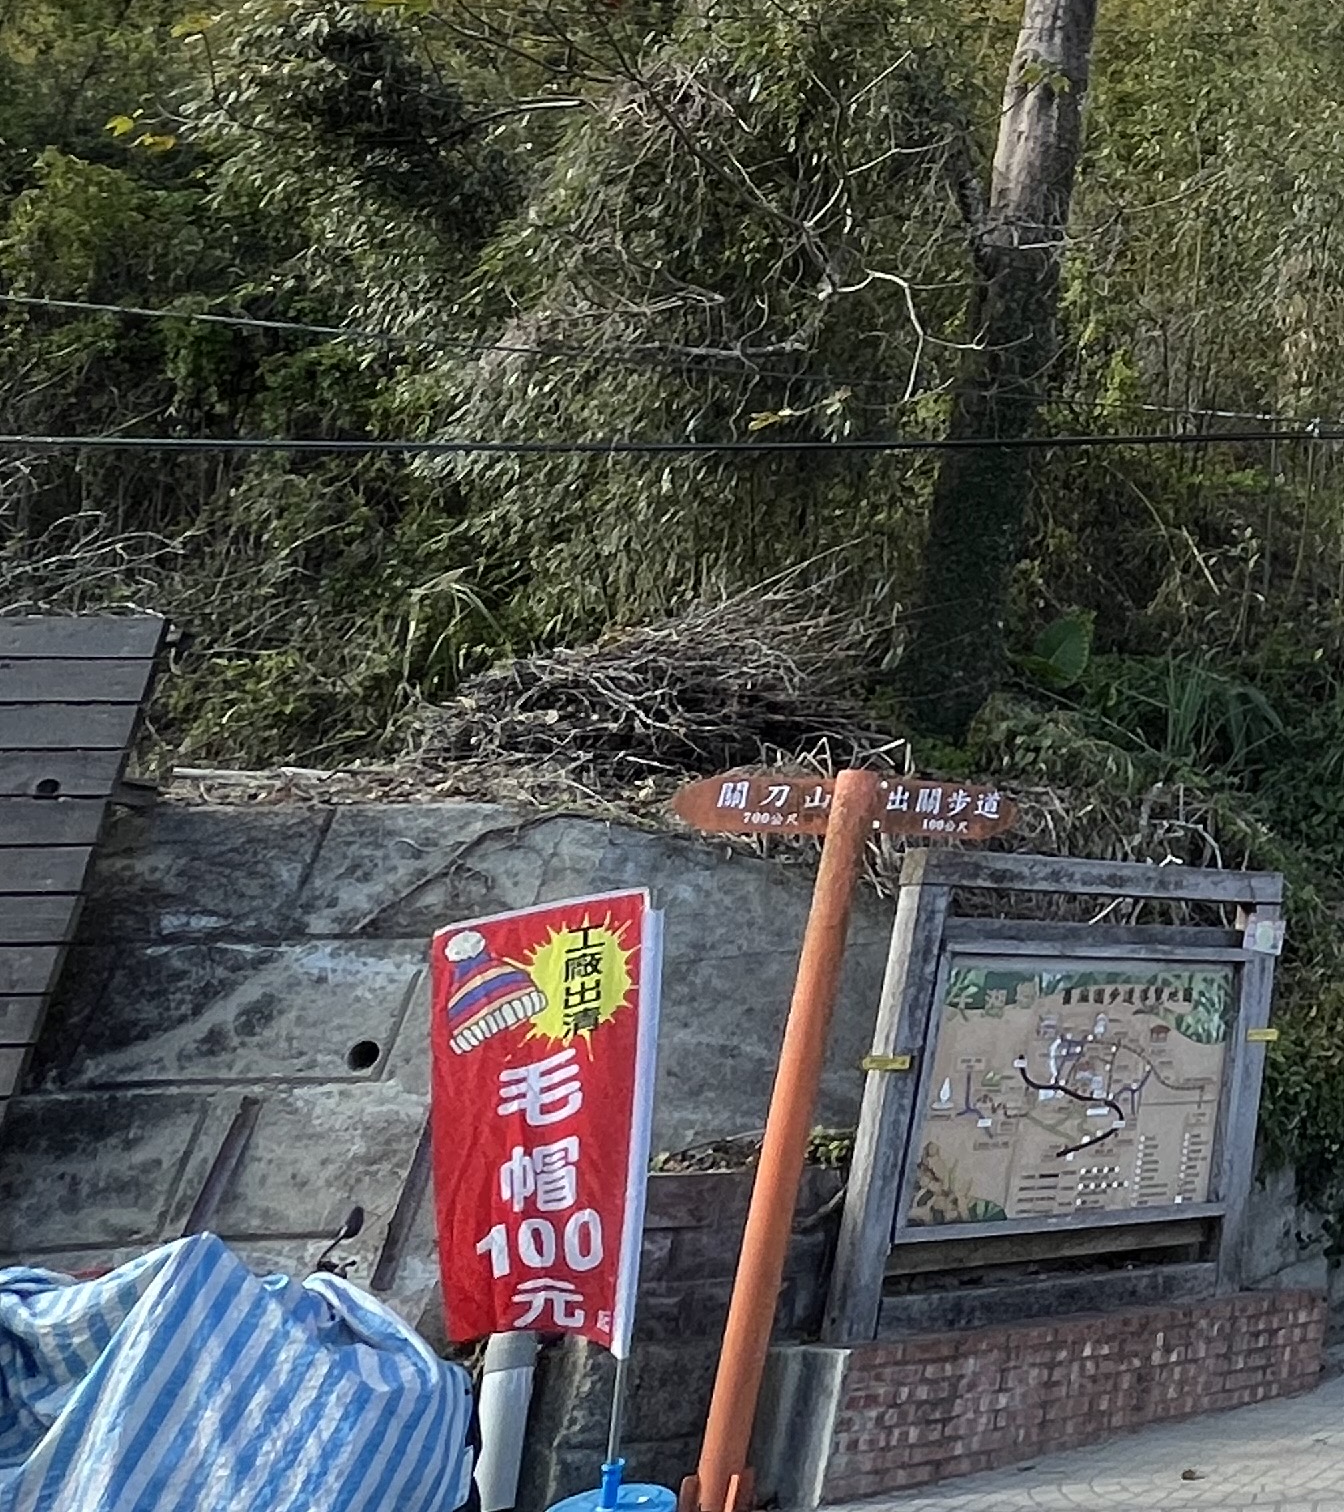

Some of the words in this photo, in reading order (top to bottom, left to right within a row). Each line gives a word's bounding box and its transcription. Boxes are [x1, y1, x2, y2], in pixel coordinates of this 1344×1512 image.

[716, 781, 831, 810] 關刀山
[886, 786, 1001, 819] 出關步道
[743, 812, 798, 826] 700公尺
[922, 818, 968, 832] 100公尺
[563, 925, 606, 1038] 工廠出清
